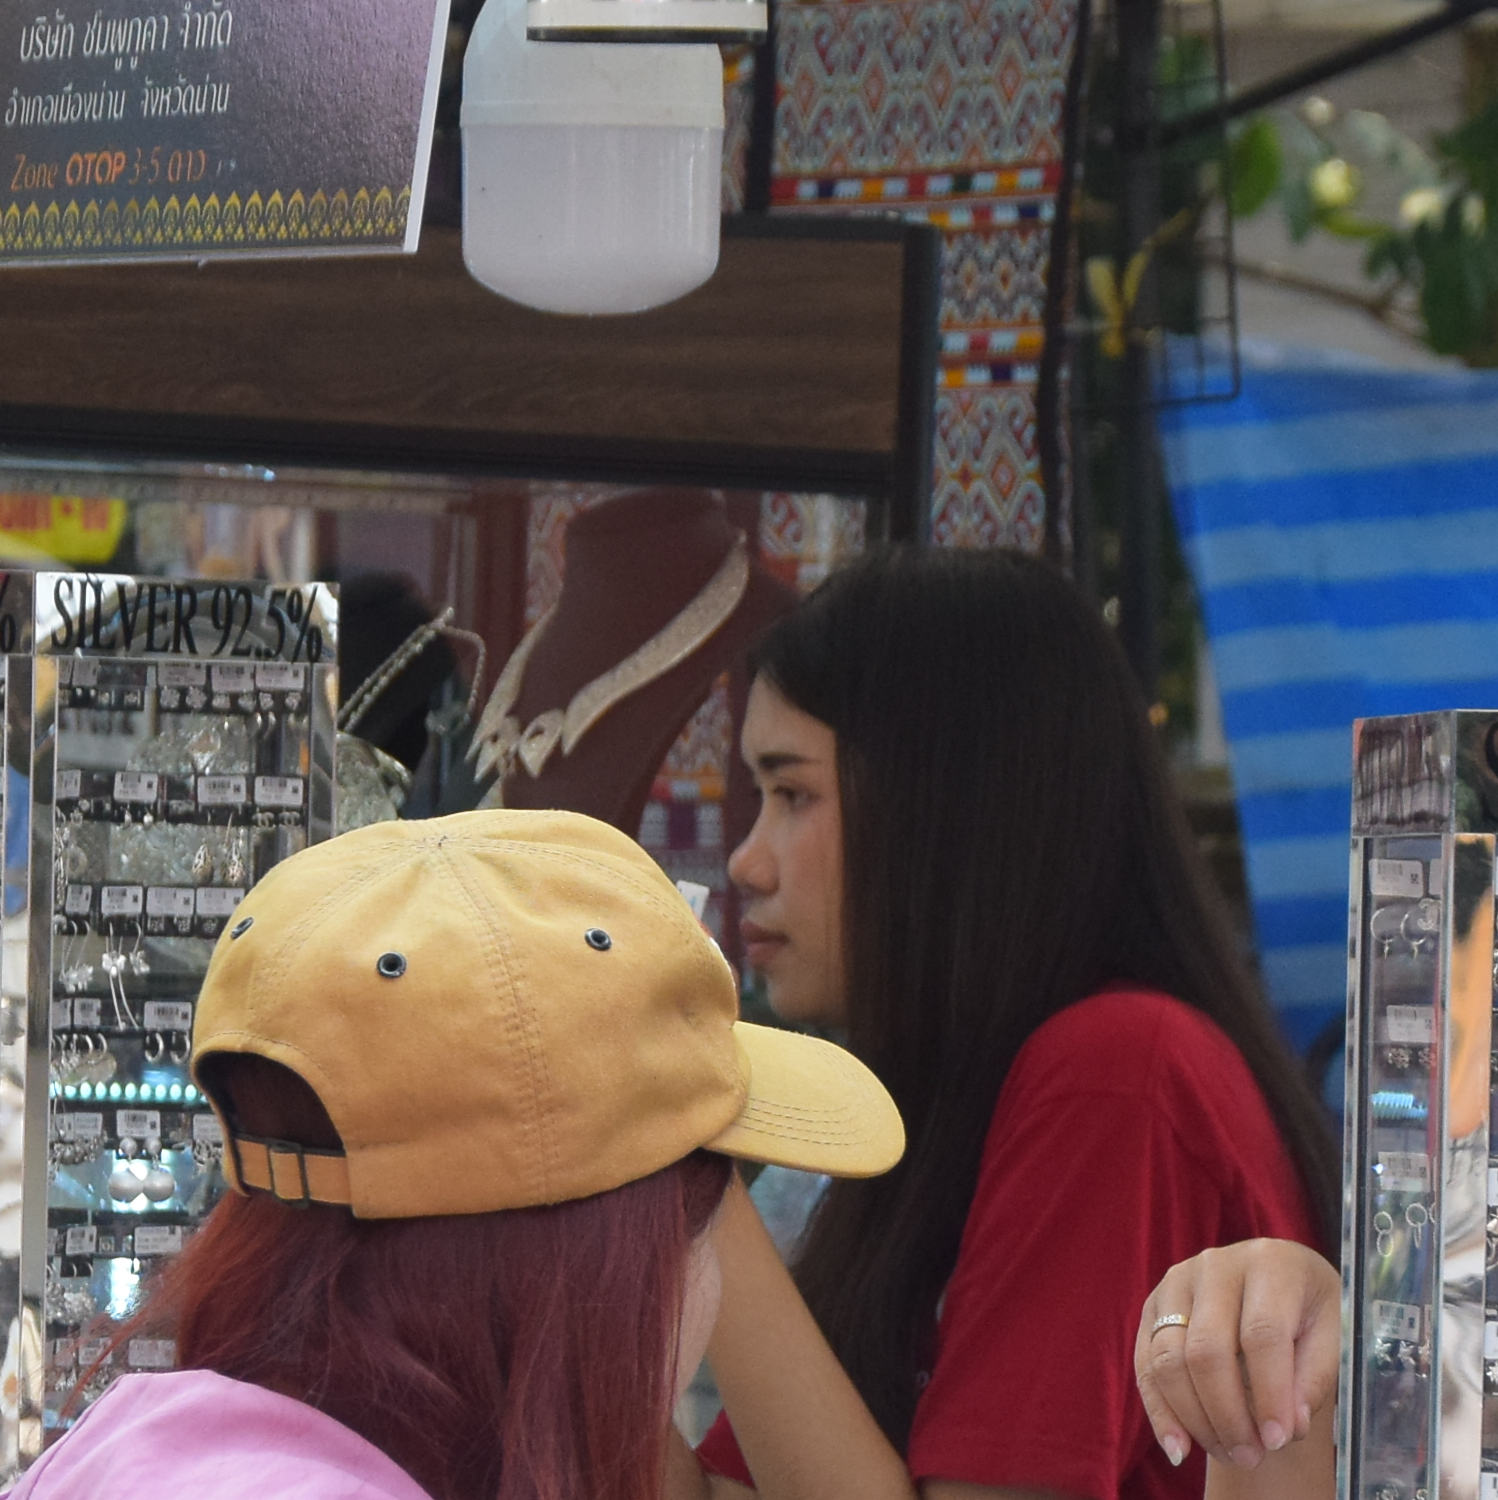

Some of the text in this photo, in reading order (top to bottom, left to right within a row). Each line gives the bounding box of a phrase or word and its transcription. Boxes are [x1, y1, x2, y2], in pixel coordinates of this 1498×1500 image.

[20, 8, 75, 62] บริษัท
[141, 73, 231, 118] จังหวัดน่าน
[11, 153, 59, 192] Zone
[66, 150, 126, 186] OTOP
[168, 148, 208, 184] ดาว
[51, 575, 324, 664] SILVER 92.5%
